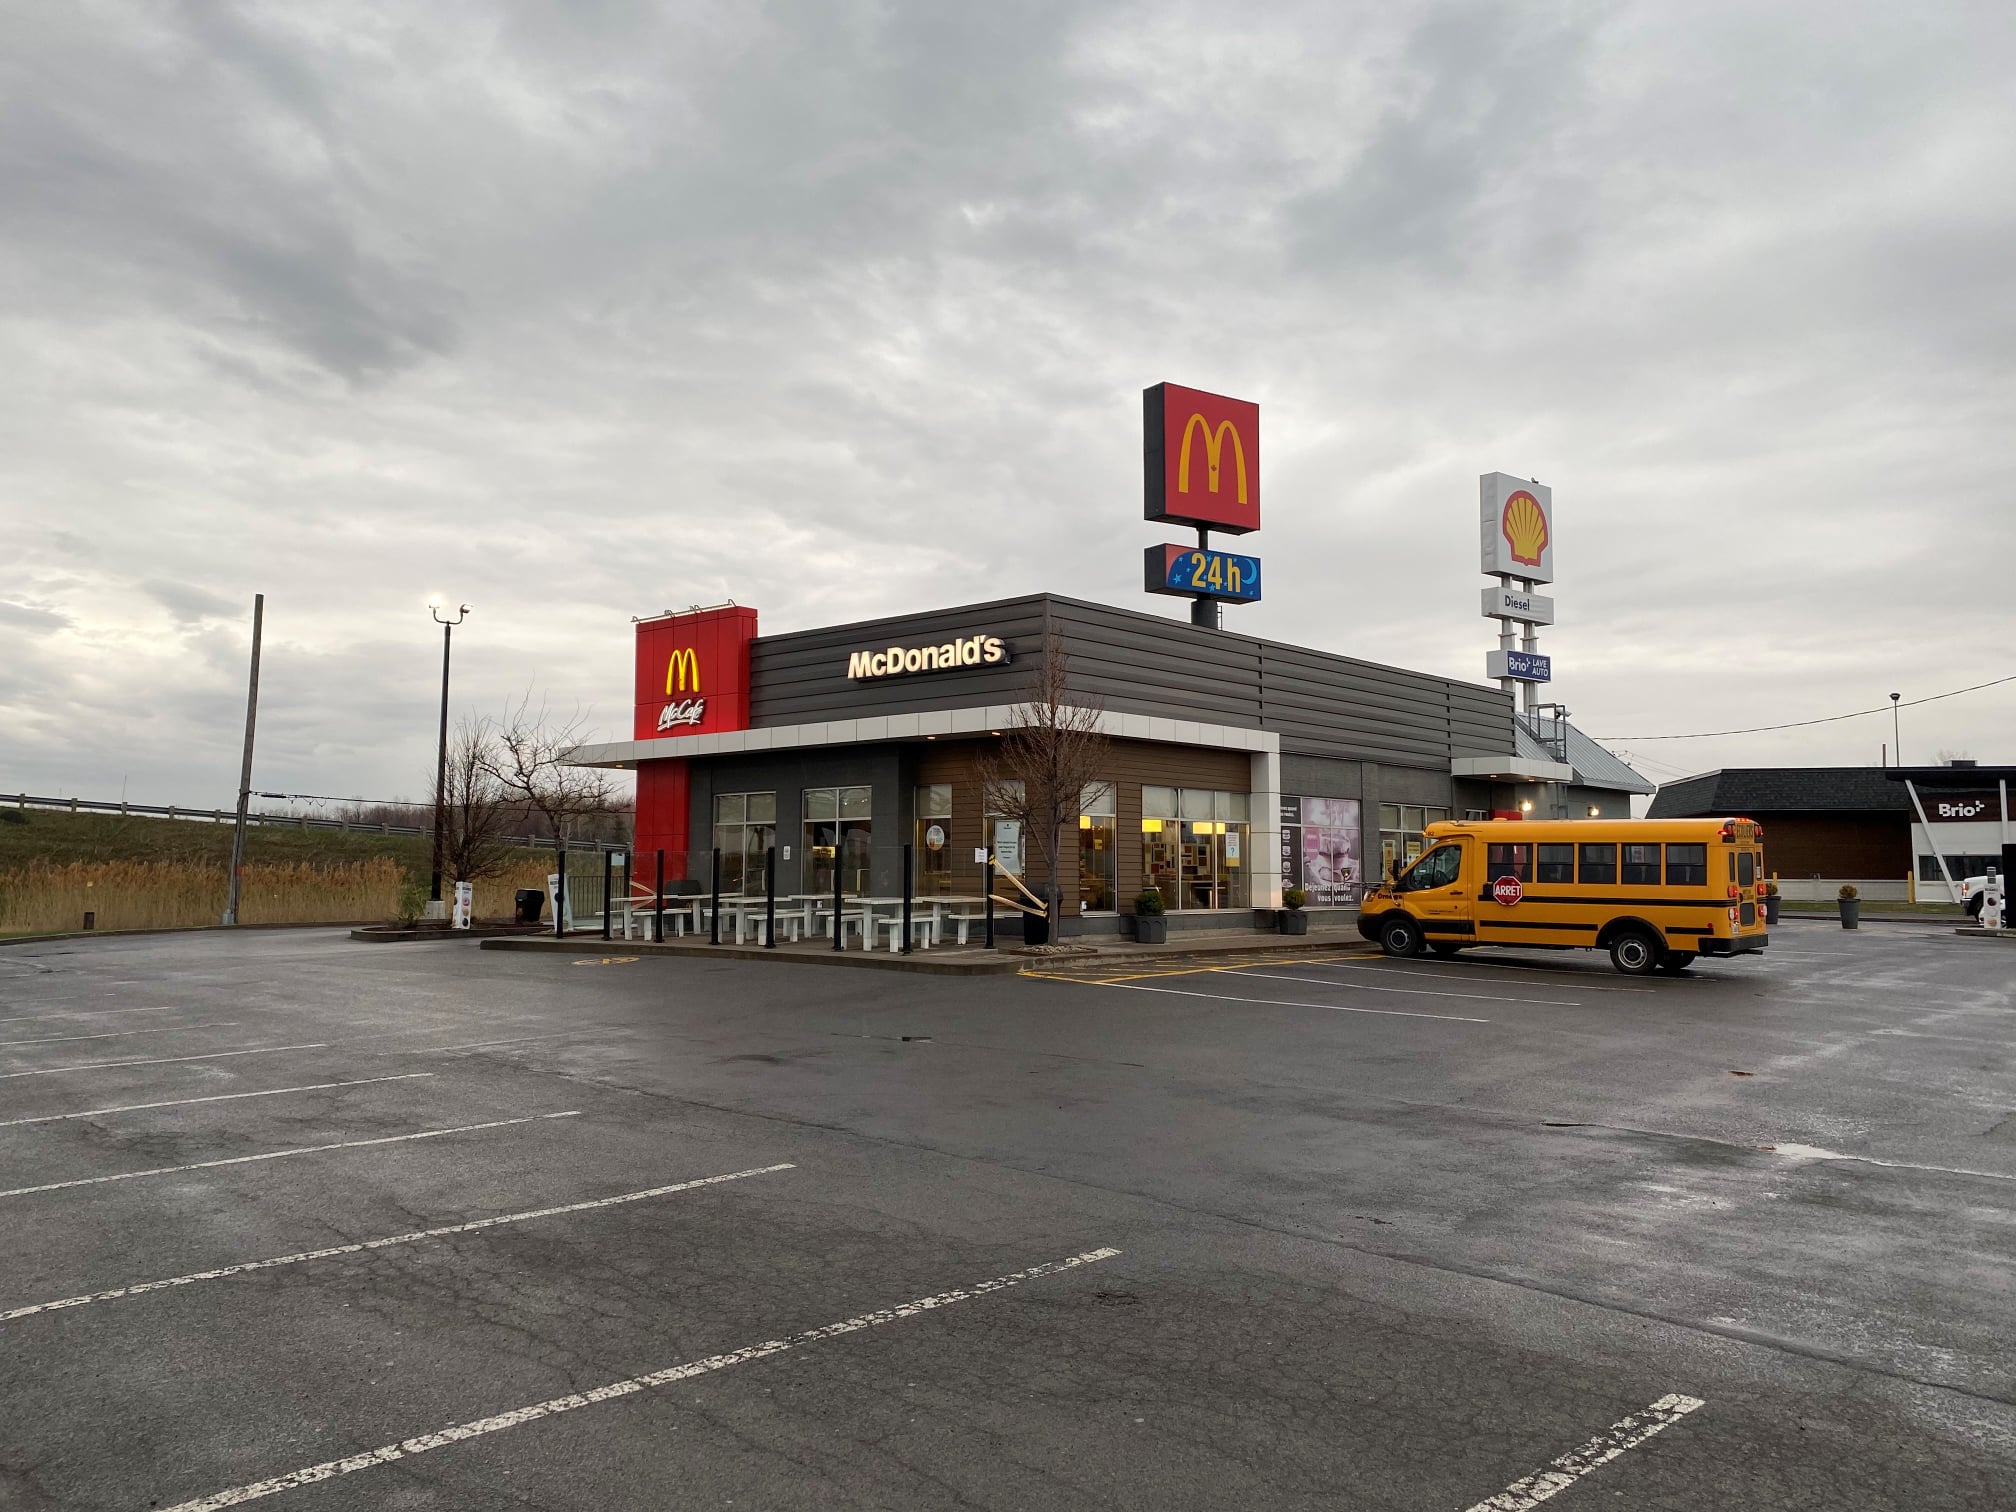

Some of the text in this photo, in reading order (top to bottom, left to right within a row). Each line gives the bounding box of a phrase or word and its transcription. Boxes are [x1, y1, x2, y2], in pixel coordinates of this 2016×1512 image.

[1505, 594, 1530, 612] Diesel
[847, 634, 1003, 680] McDonald's
[1508, 656, 1527, 672] Brio
[1532, 658, 1547, 668] LAVE
[1531, 667, 1549, 677] AUTO
[1938, 802, 1976, 817] Brio
